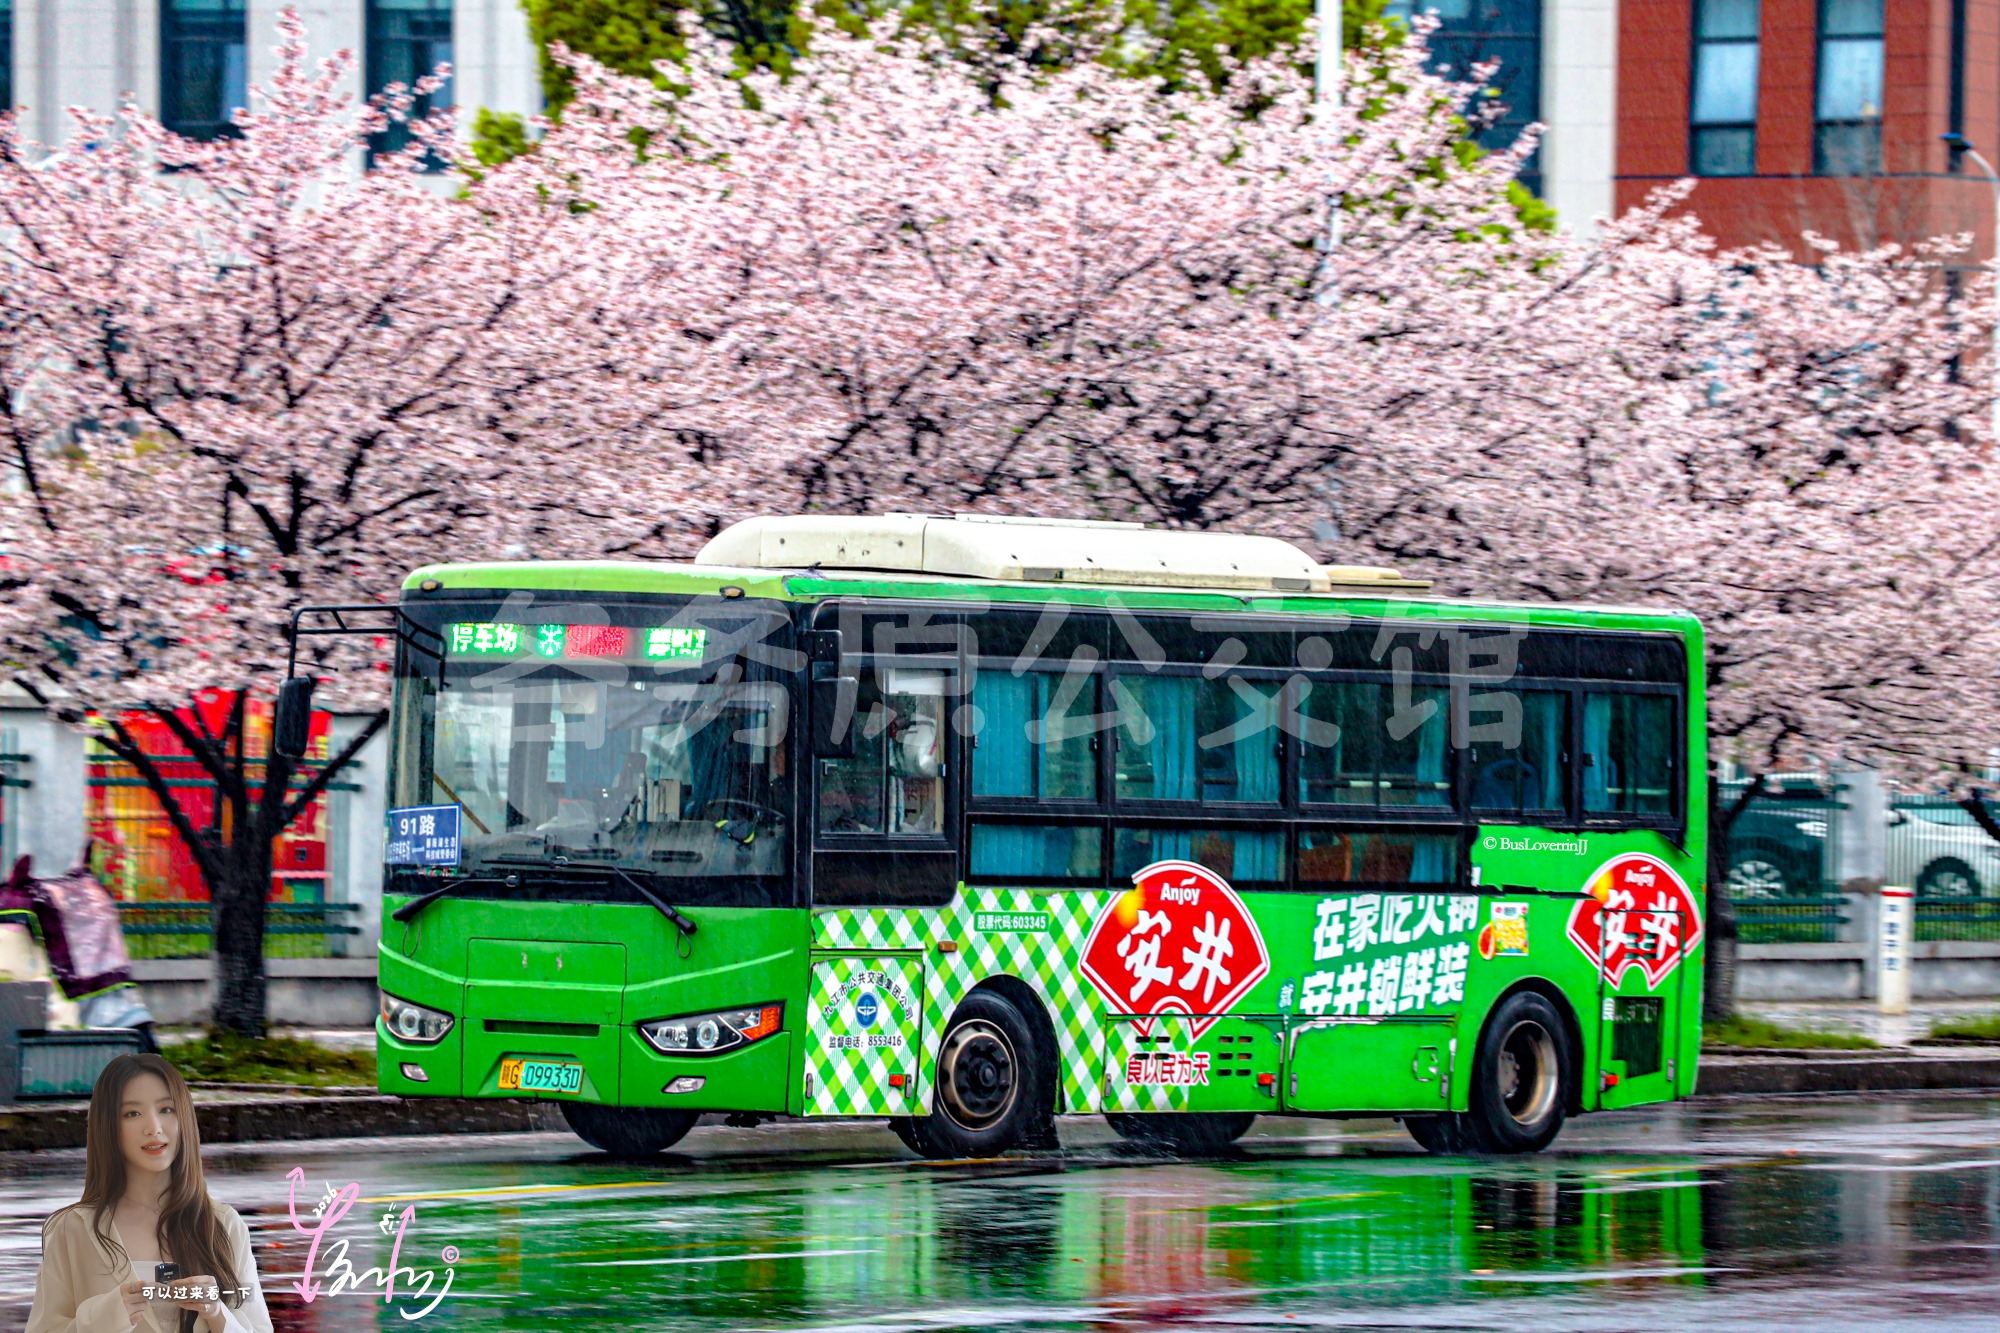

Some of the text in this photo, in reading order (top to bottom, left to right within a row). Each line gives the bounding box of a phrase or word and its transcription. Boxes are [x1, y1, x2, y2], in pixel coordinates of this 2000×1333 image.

[453, 623, 519, 652] 停车场
[400, 813, 435, 836] 91路
[1160, 882, 1200, 906] Anjoy
[1592, 888, 1680, 961] 安井
[1117, 909, 1235, 1004] 安井
[823, 971, 913, 1021] 九江市公共交通集团公司
